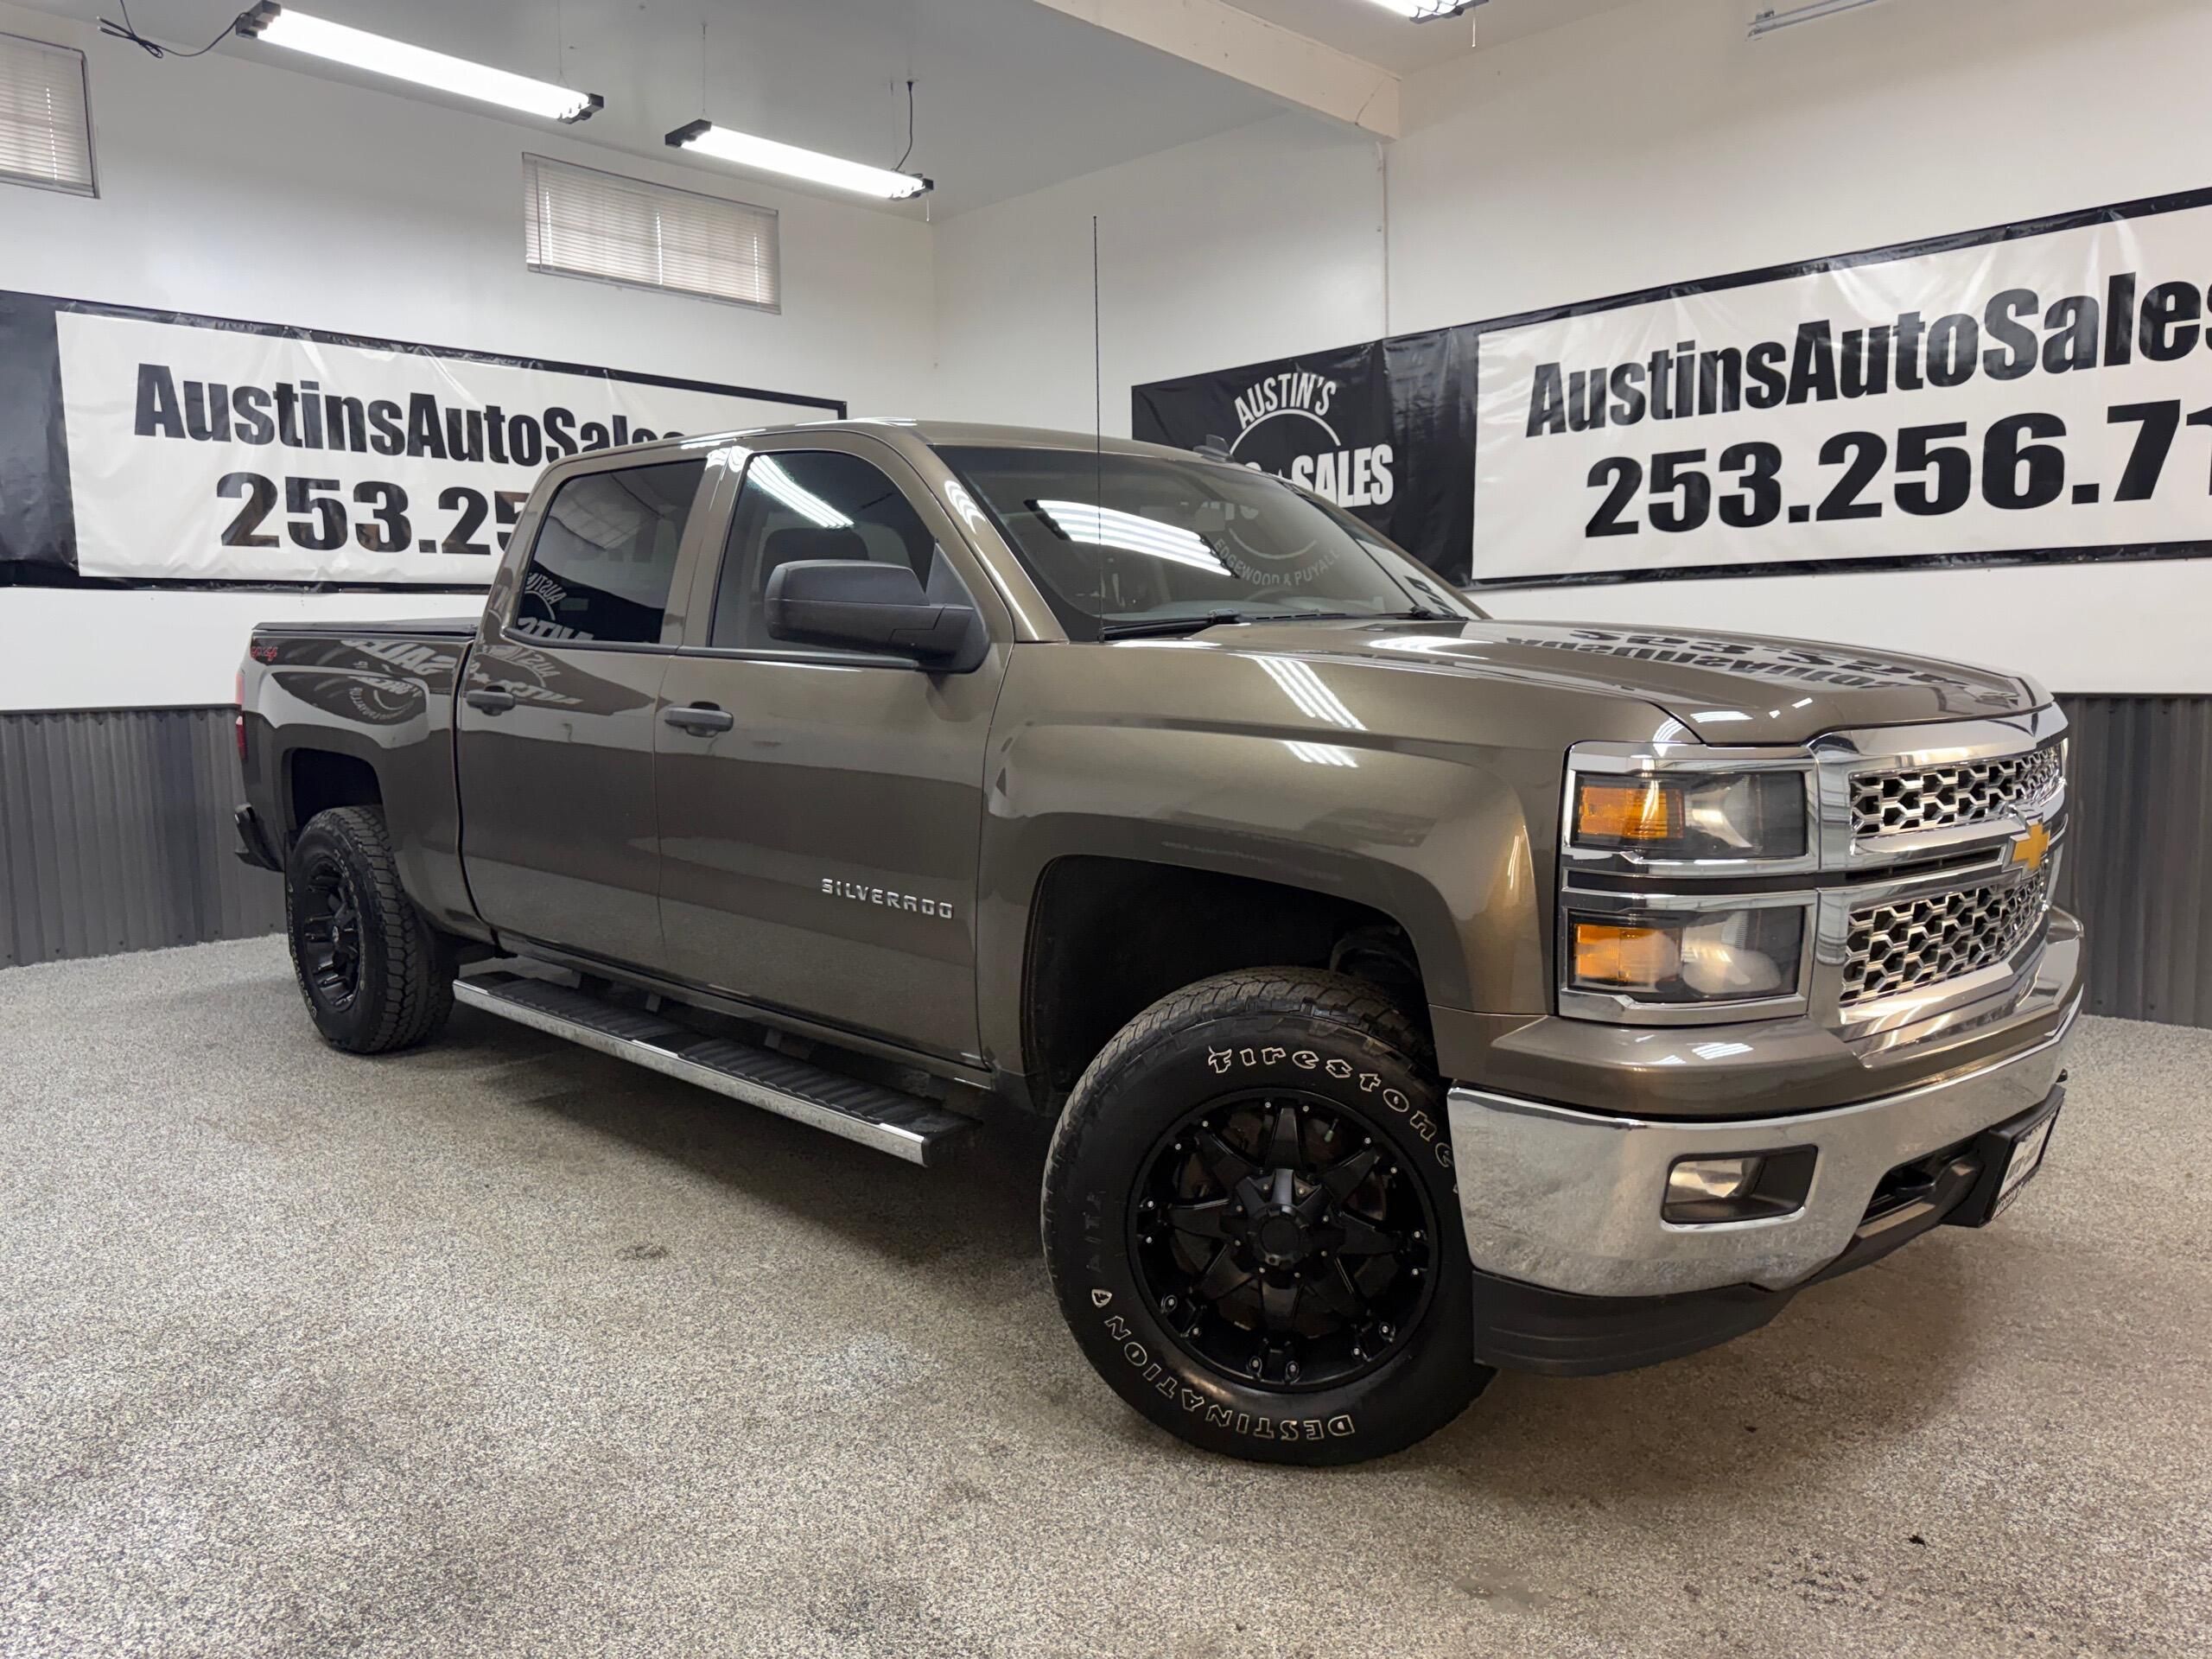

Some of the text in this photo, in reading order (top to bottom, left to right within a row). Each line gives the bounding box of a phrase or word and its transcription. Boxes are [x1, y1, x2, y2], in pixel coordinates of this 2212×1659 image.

[1525, 271, 2212, 439] AustinsAutoSale
[134, 363, 685, 467] AustinsAutoSal
[1234, 372, 1337, 429] AUSTIN'S
[1292, 444, 1394, 508] SALES
[1296, 550, 1339, 586] PUYALL
[822, 878, 953, 919] SILVERADO
[1104, 1315, 1356, 1440] DESTINATION
